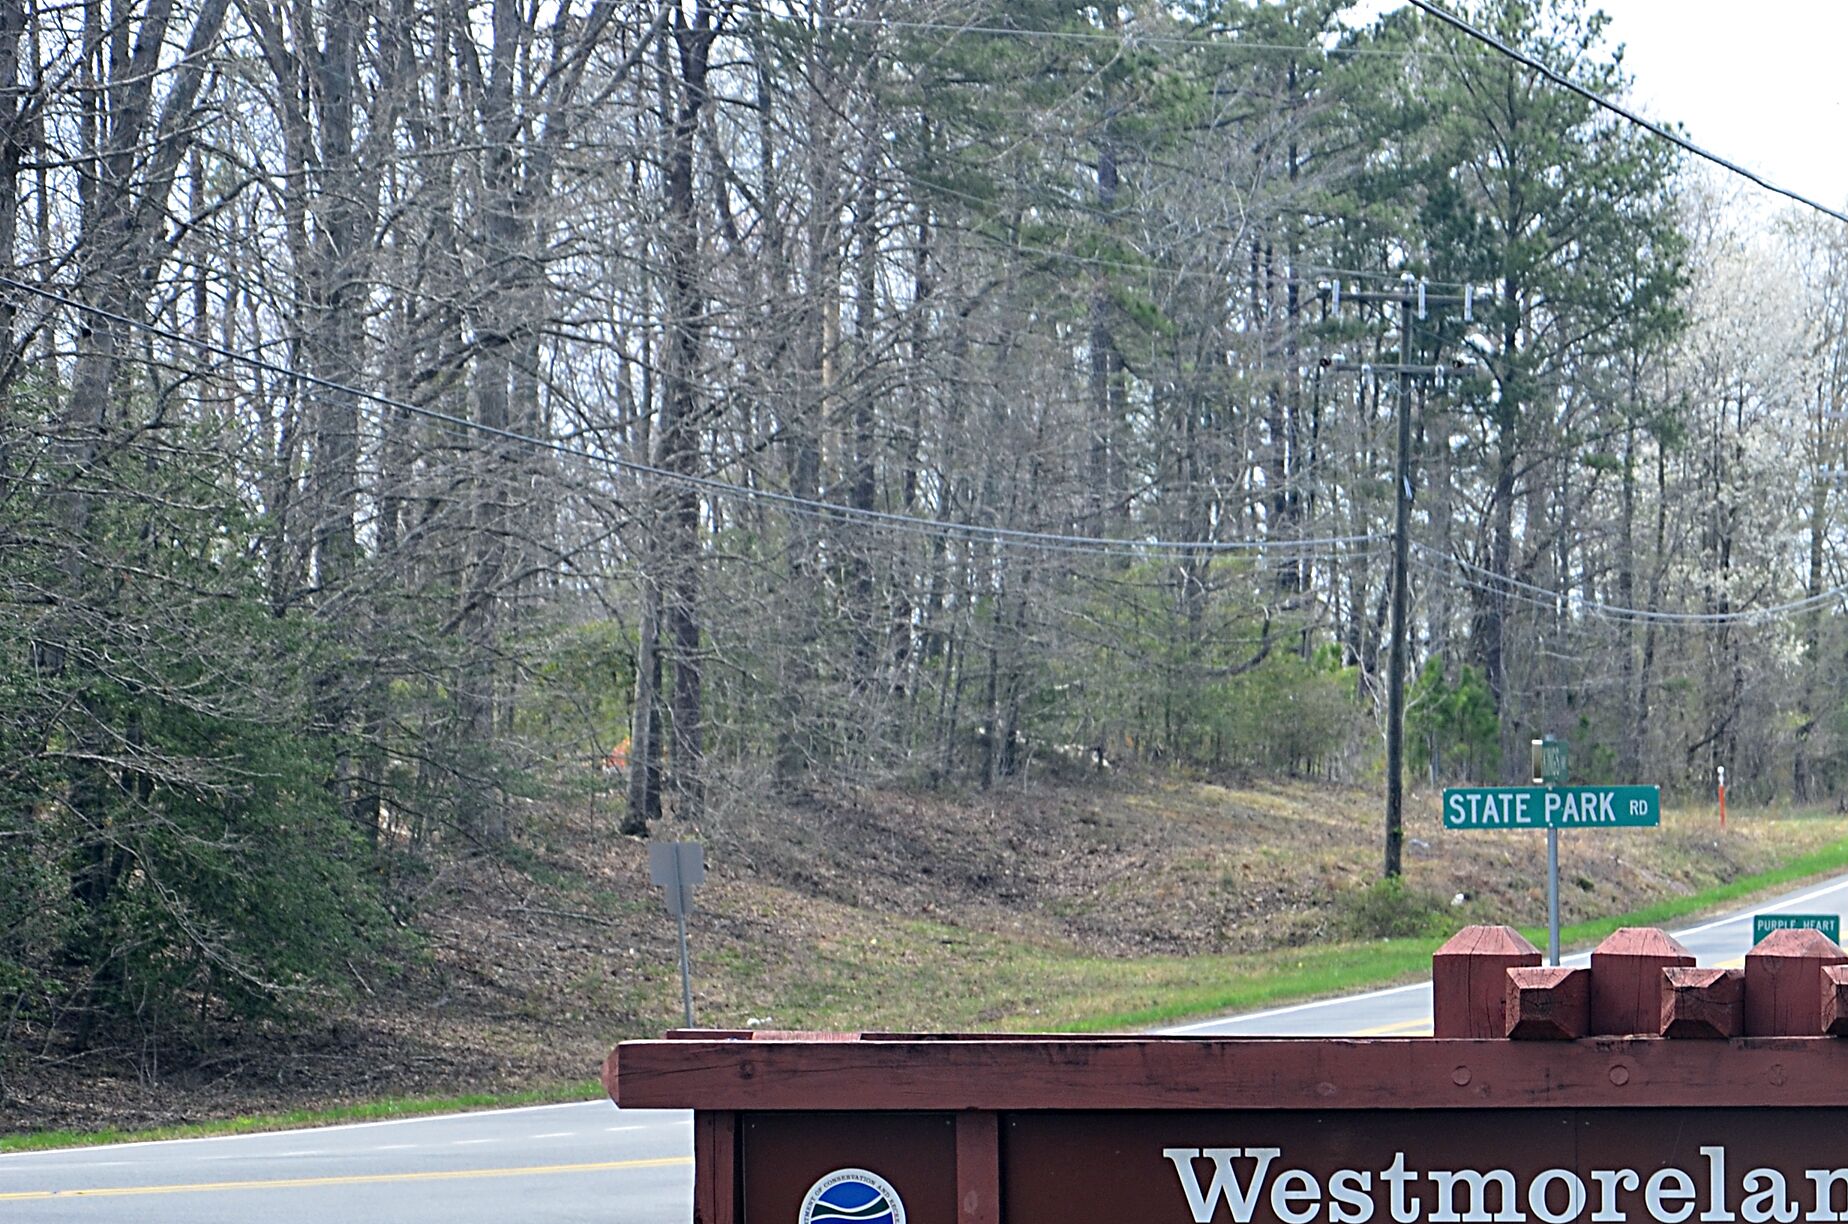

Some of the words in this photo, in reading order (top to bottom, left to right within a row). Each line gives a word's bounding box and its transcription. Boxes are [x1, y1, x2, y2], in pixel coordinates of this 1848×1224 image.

[1449, 793, 1531, 825] STATE
[1544, 791, 1616, 823] PARK
[1629, 799, 1648, 816] RD
[1757, 919, 1797, 932] PURPLE
[1803, 919, 1836, 932] HEART
[815, 1187, 823, 1195] OF
[824, 1175, 876, 1187] CONSERVATION
[877, 1185, 889, 1198] AND
